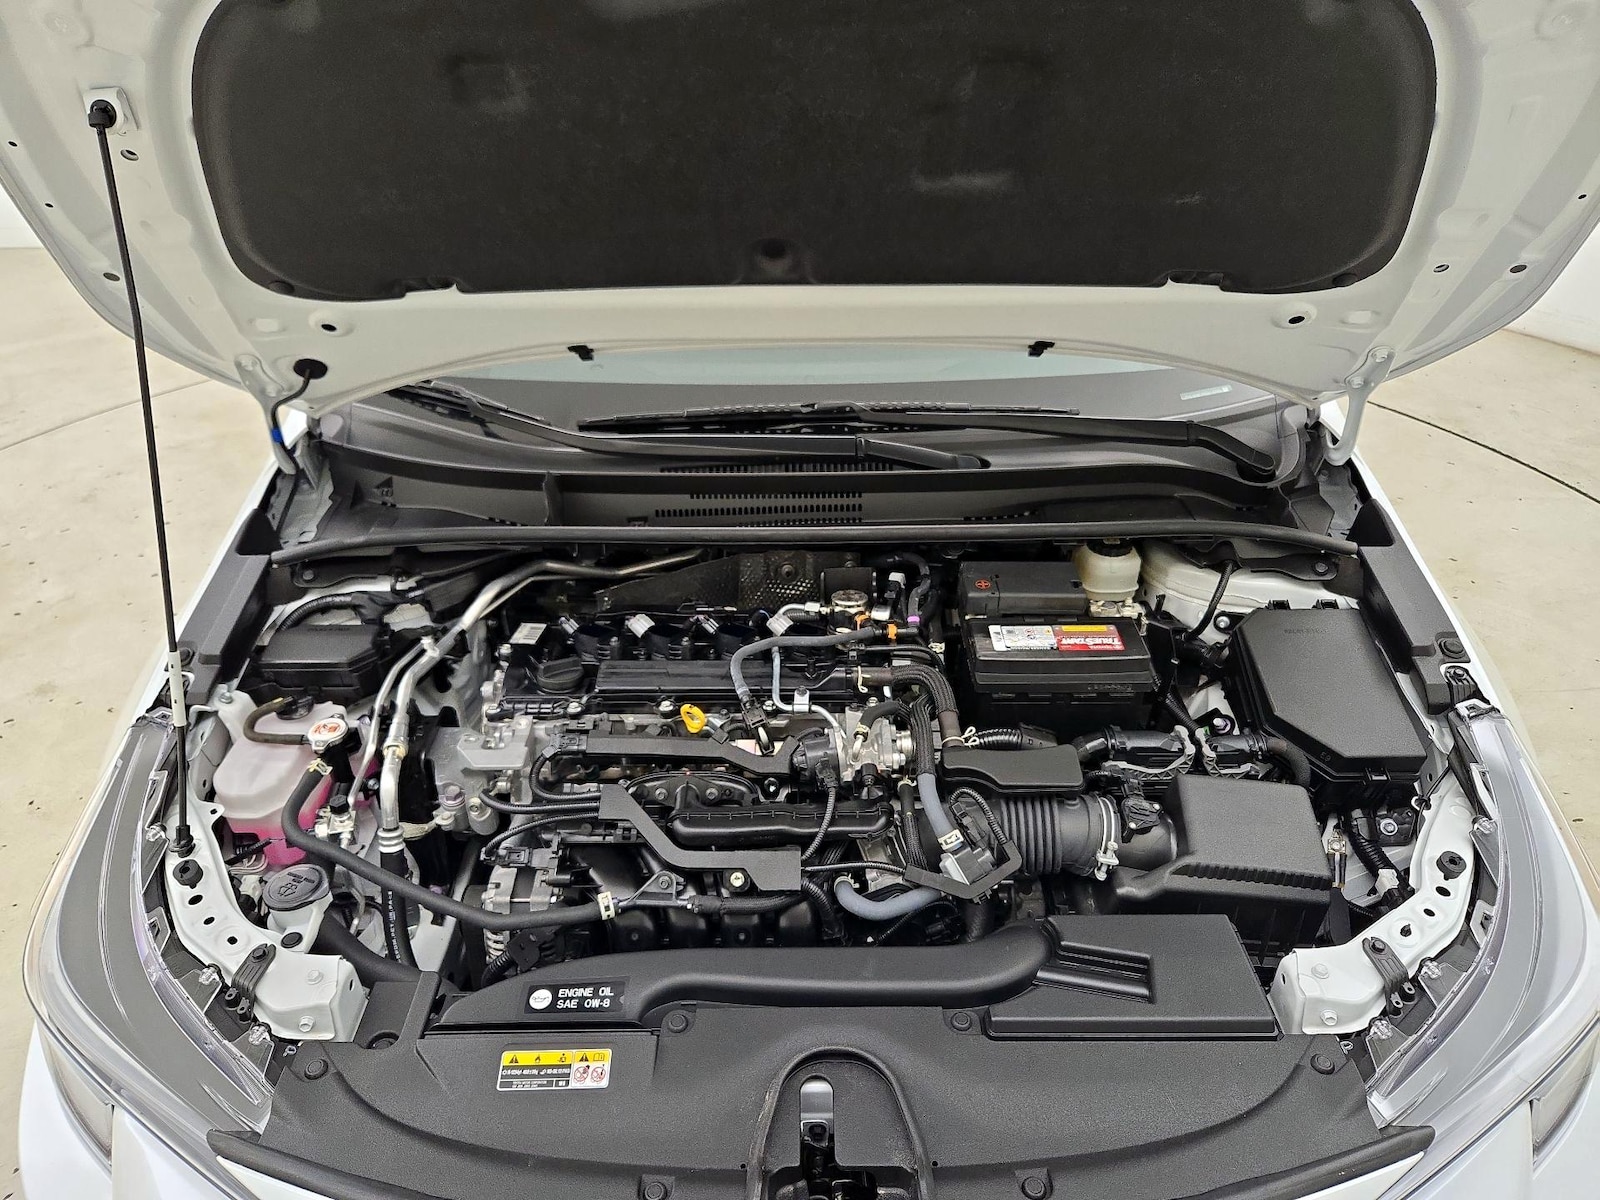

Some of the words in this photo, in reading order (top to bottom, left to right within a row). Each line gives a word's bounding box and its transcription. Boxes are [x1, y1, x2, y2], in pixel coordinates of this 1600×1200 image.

[557, 987, 594, 998] ENGINE
[598, 986, 614, 996] OIL
[556, 999, 579, 1009] SAE
[584, 998, 611, 1008] 0W-8
